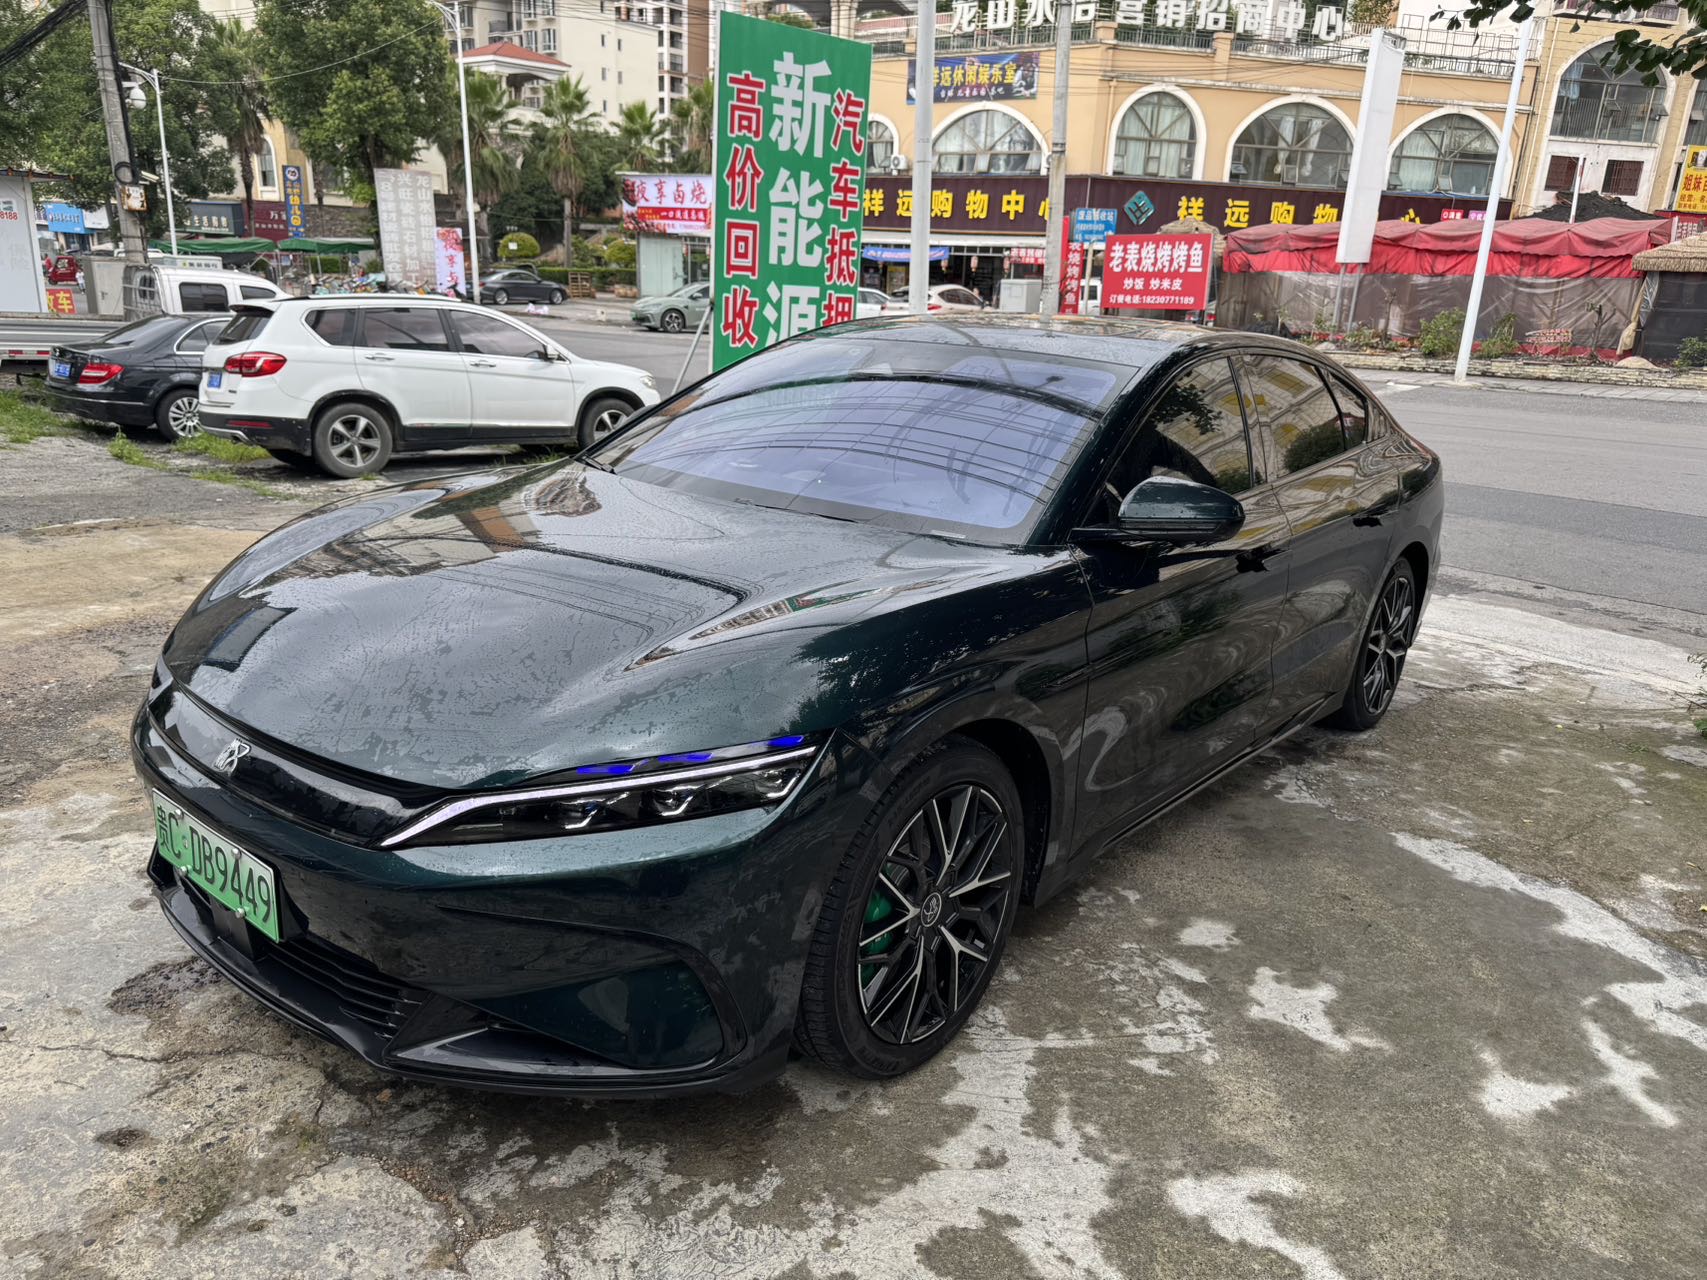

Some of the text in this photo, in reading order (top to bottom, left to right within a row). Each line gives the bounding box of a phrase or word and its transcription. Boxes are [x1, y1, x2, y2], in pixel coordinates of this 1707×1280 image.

[722, 71, 765, 347] 高价回收
[763, 51, 833, 348] 新能源
[822, 89, 865, 328] 汽车抵押
[1109, 241, 1203, 273] 老表烧烤烤鱼
[1177, 195, 1422, 229] 祥远购物
[1123, 278, 1182, 290] 炒饭 炒米皮
